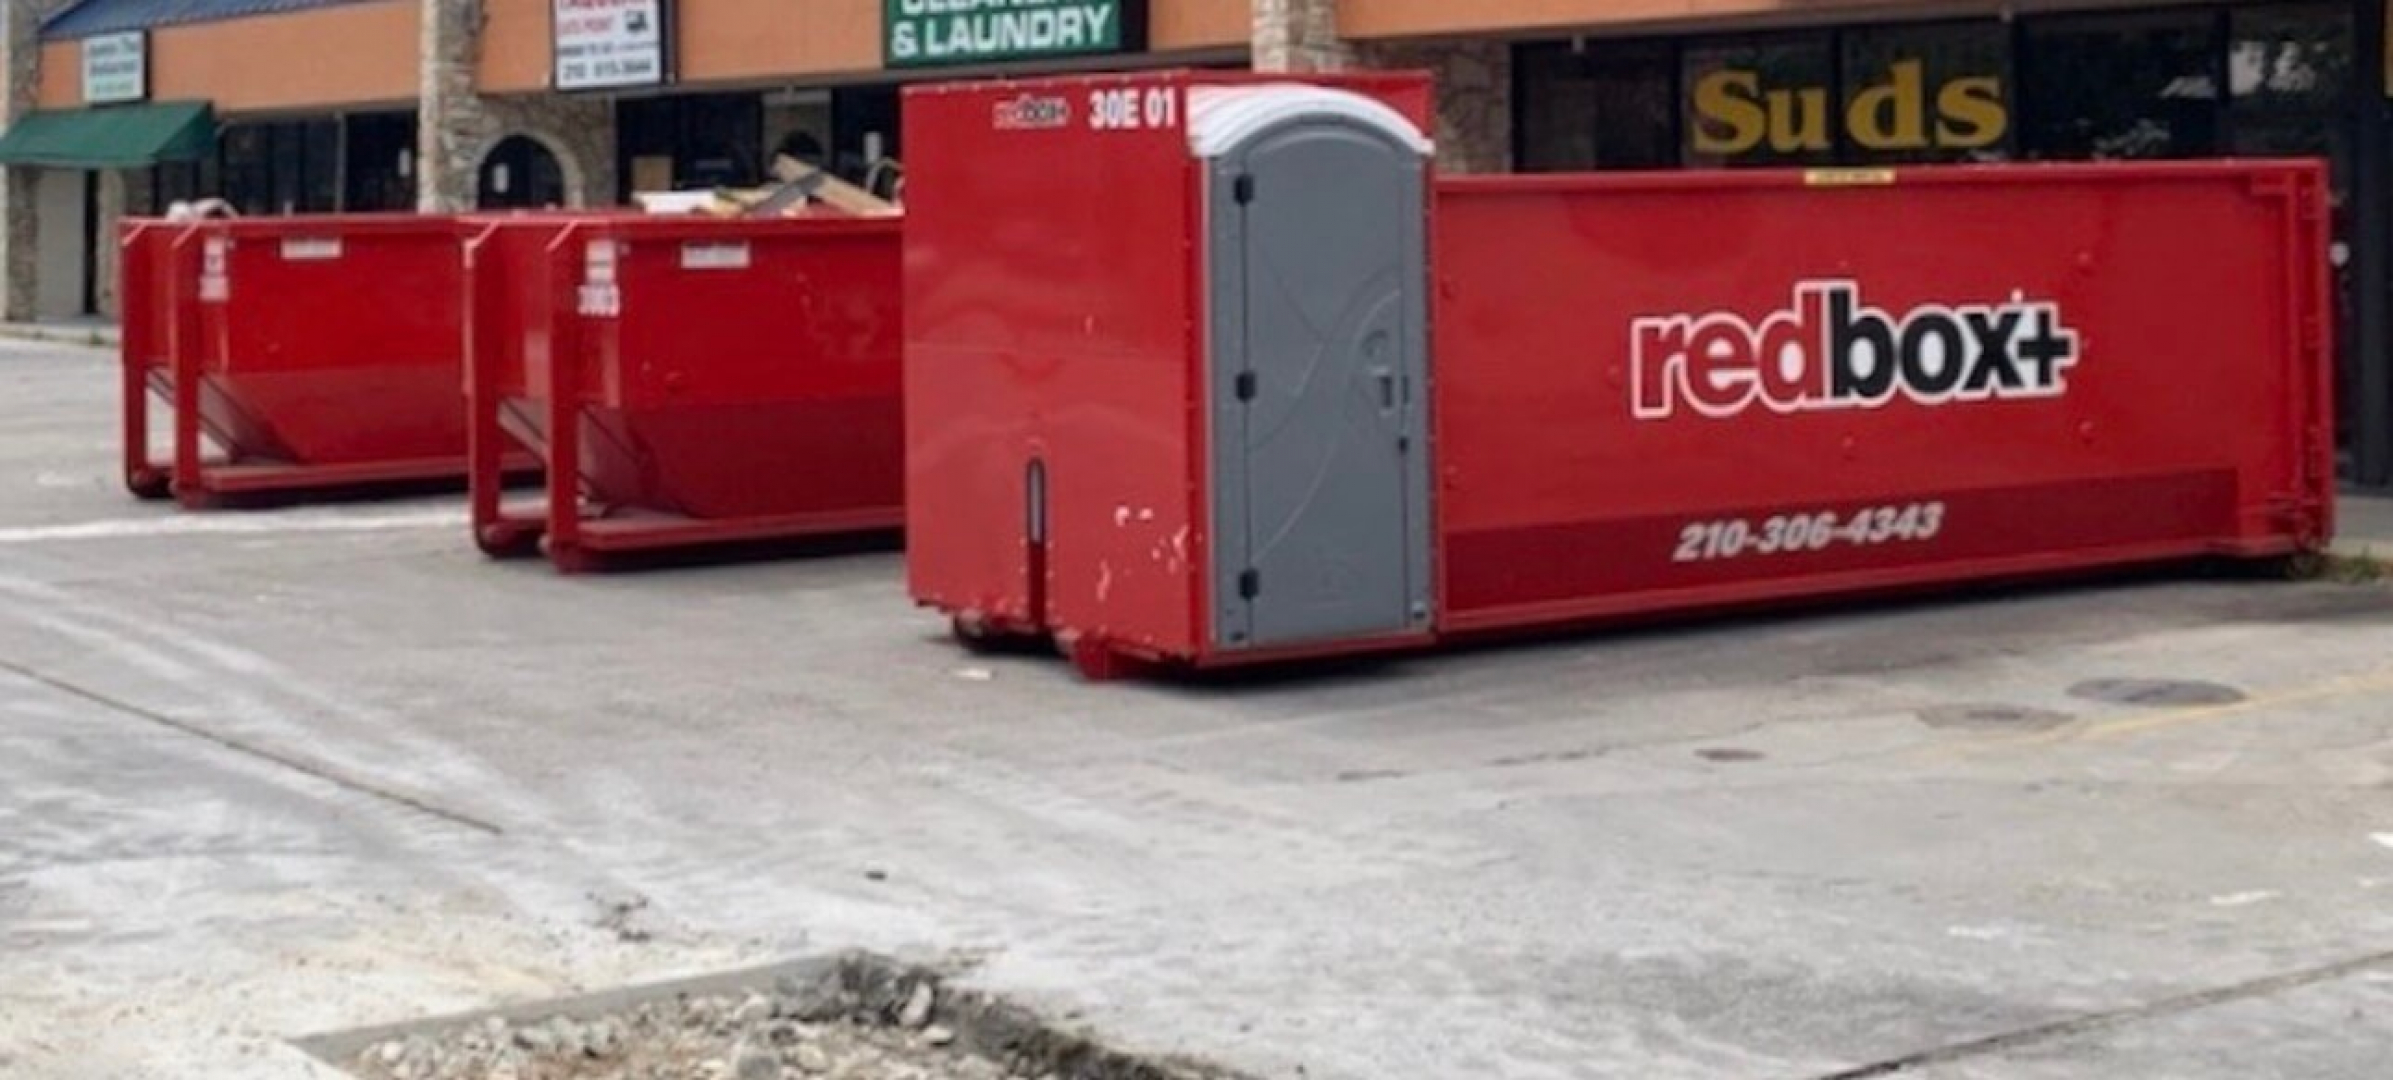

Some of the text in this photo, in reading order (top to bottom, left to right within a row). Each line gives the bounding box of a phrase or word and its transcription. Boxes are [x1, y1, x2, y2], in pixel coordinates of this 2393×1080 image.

[890, 4, 1112, 57] & LAUNDRY
[1089, 89, 1140, 129] 30E
[1145, 88, 1175, 127] 01
[1631, 279, 2081, 418] redbox+
[1672, 502, 1945, 562] 210-306-4343
